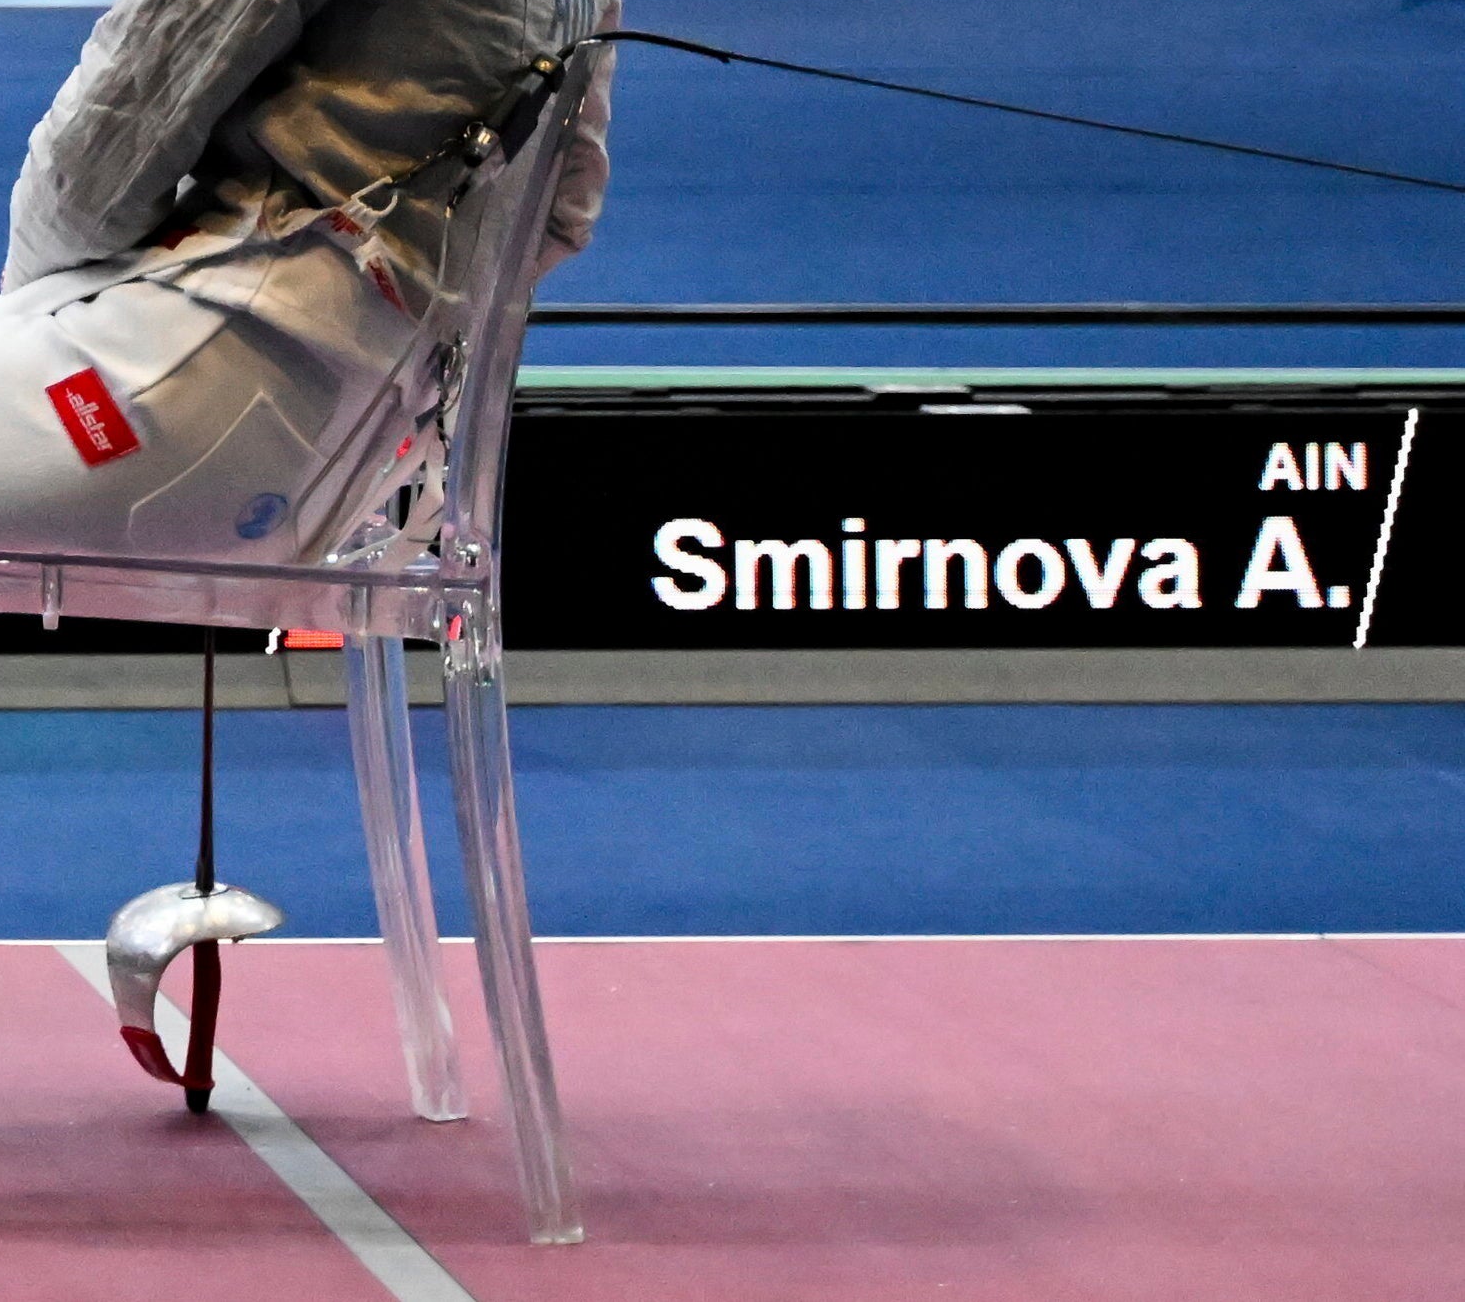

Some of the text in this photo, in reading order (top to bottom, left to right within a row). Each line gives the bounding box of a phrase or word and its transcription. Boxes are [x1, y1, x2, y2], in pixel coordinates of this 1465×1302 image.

[65, 387, 114, 452] allstar
[1257, 441, 1368, 492] AIN
[650, 515, 1351, 611] Smirnova A.
